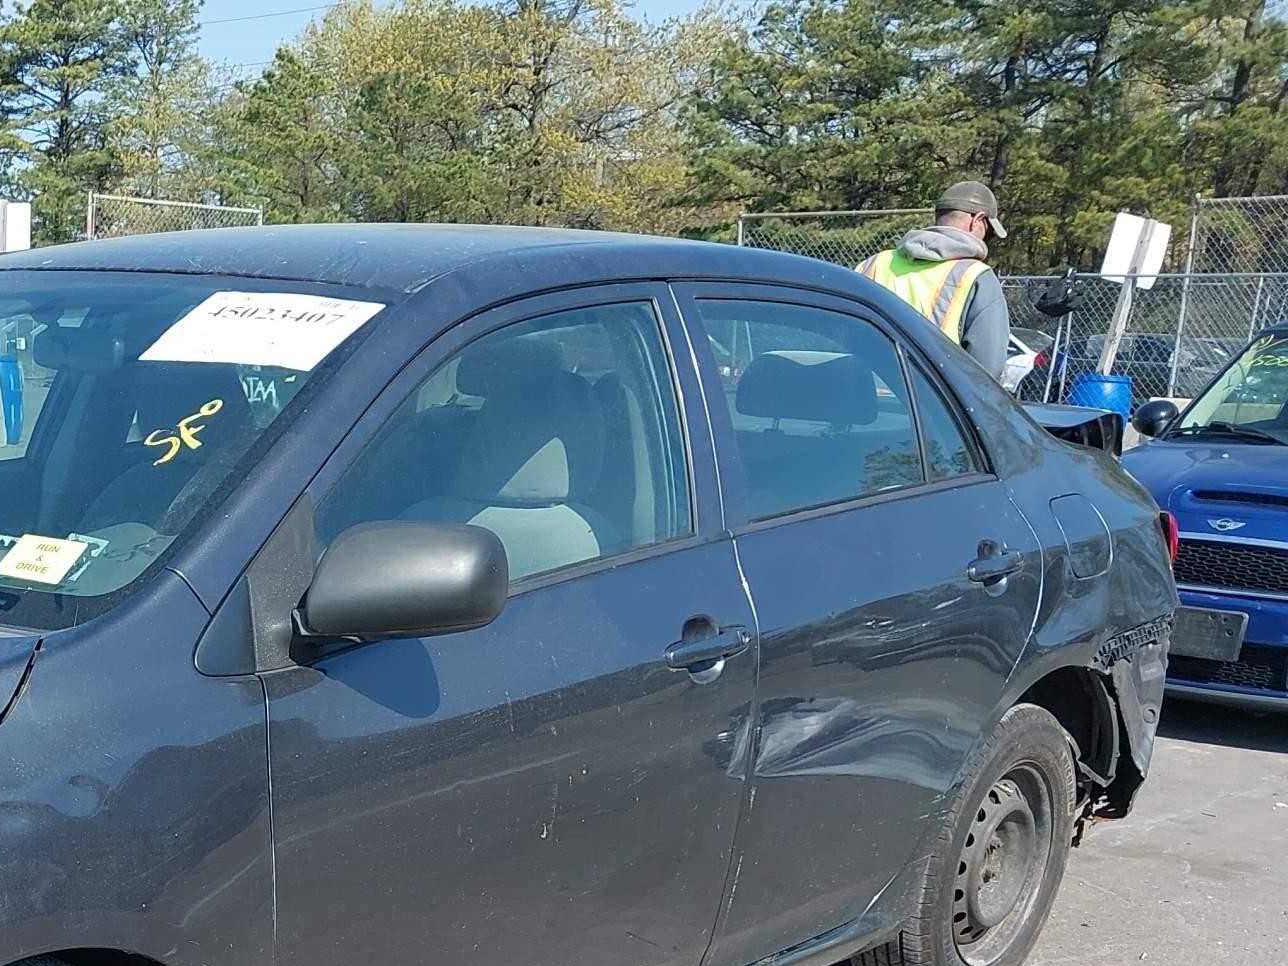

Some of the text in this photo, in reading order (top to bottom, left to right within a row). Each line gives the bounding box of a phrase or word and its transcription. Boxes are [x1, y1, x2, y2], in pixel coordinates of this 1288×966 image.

[208, 305, 346, 325] 45023407
[36, 543, 61, 553] RUN
[36, 554, 44, 562] &
[15, 562, 49, 574] DRIVE
